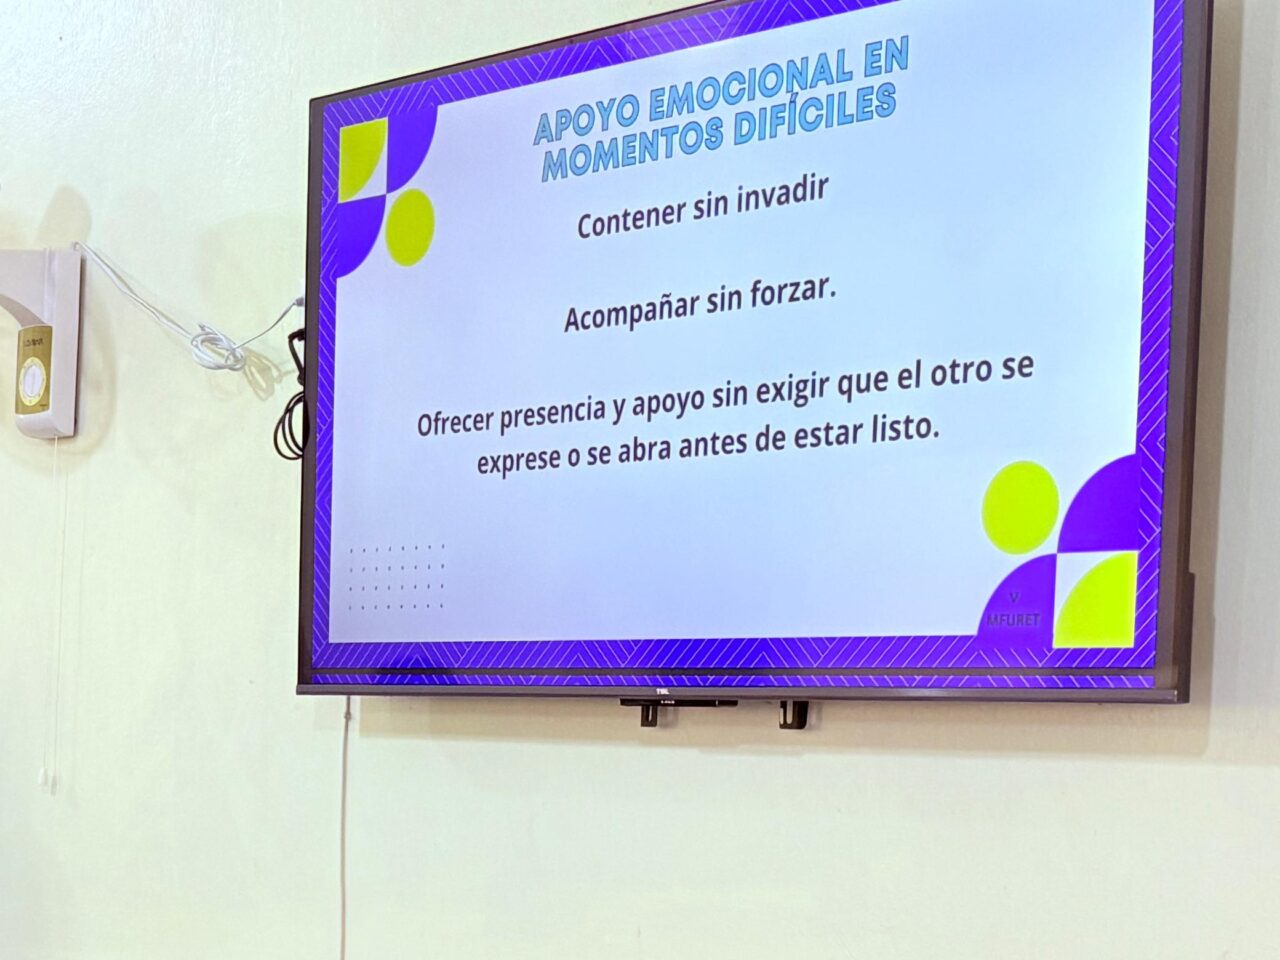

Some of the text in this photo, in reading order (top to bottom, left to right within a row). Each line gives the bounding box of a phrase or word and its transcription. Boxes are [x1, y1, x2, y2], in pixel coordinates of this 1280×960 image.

[533, 35, 910, 146] APOYO EMOCIONAL EN
[541, 81, 897, 183] MOMENTOS DIFÍCILES
[577, 172, 830, 239] Contener sin invadir
[564, 276, 837, 333] Acompañar sin forzar.
[417, 355, 1034, 437] Ofrecer presencia y apoyo sin exigir que el otro se
[477, 414, 940, 480] exprese o se abra antes de estar listo.
